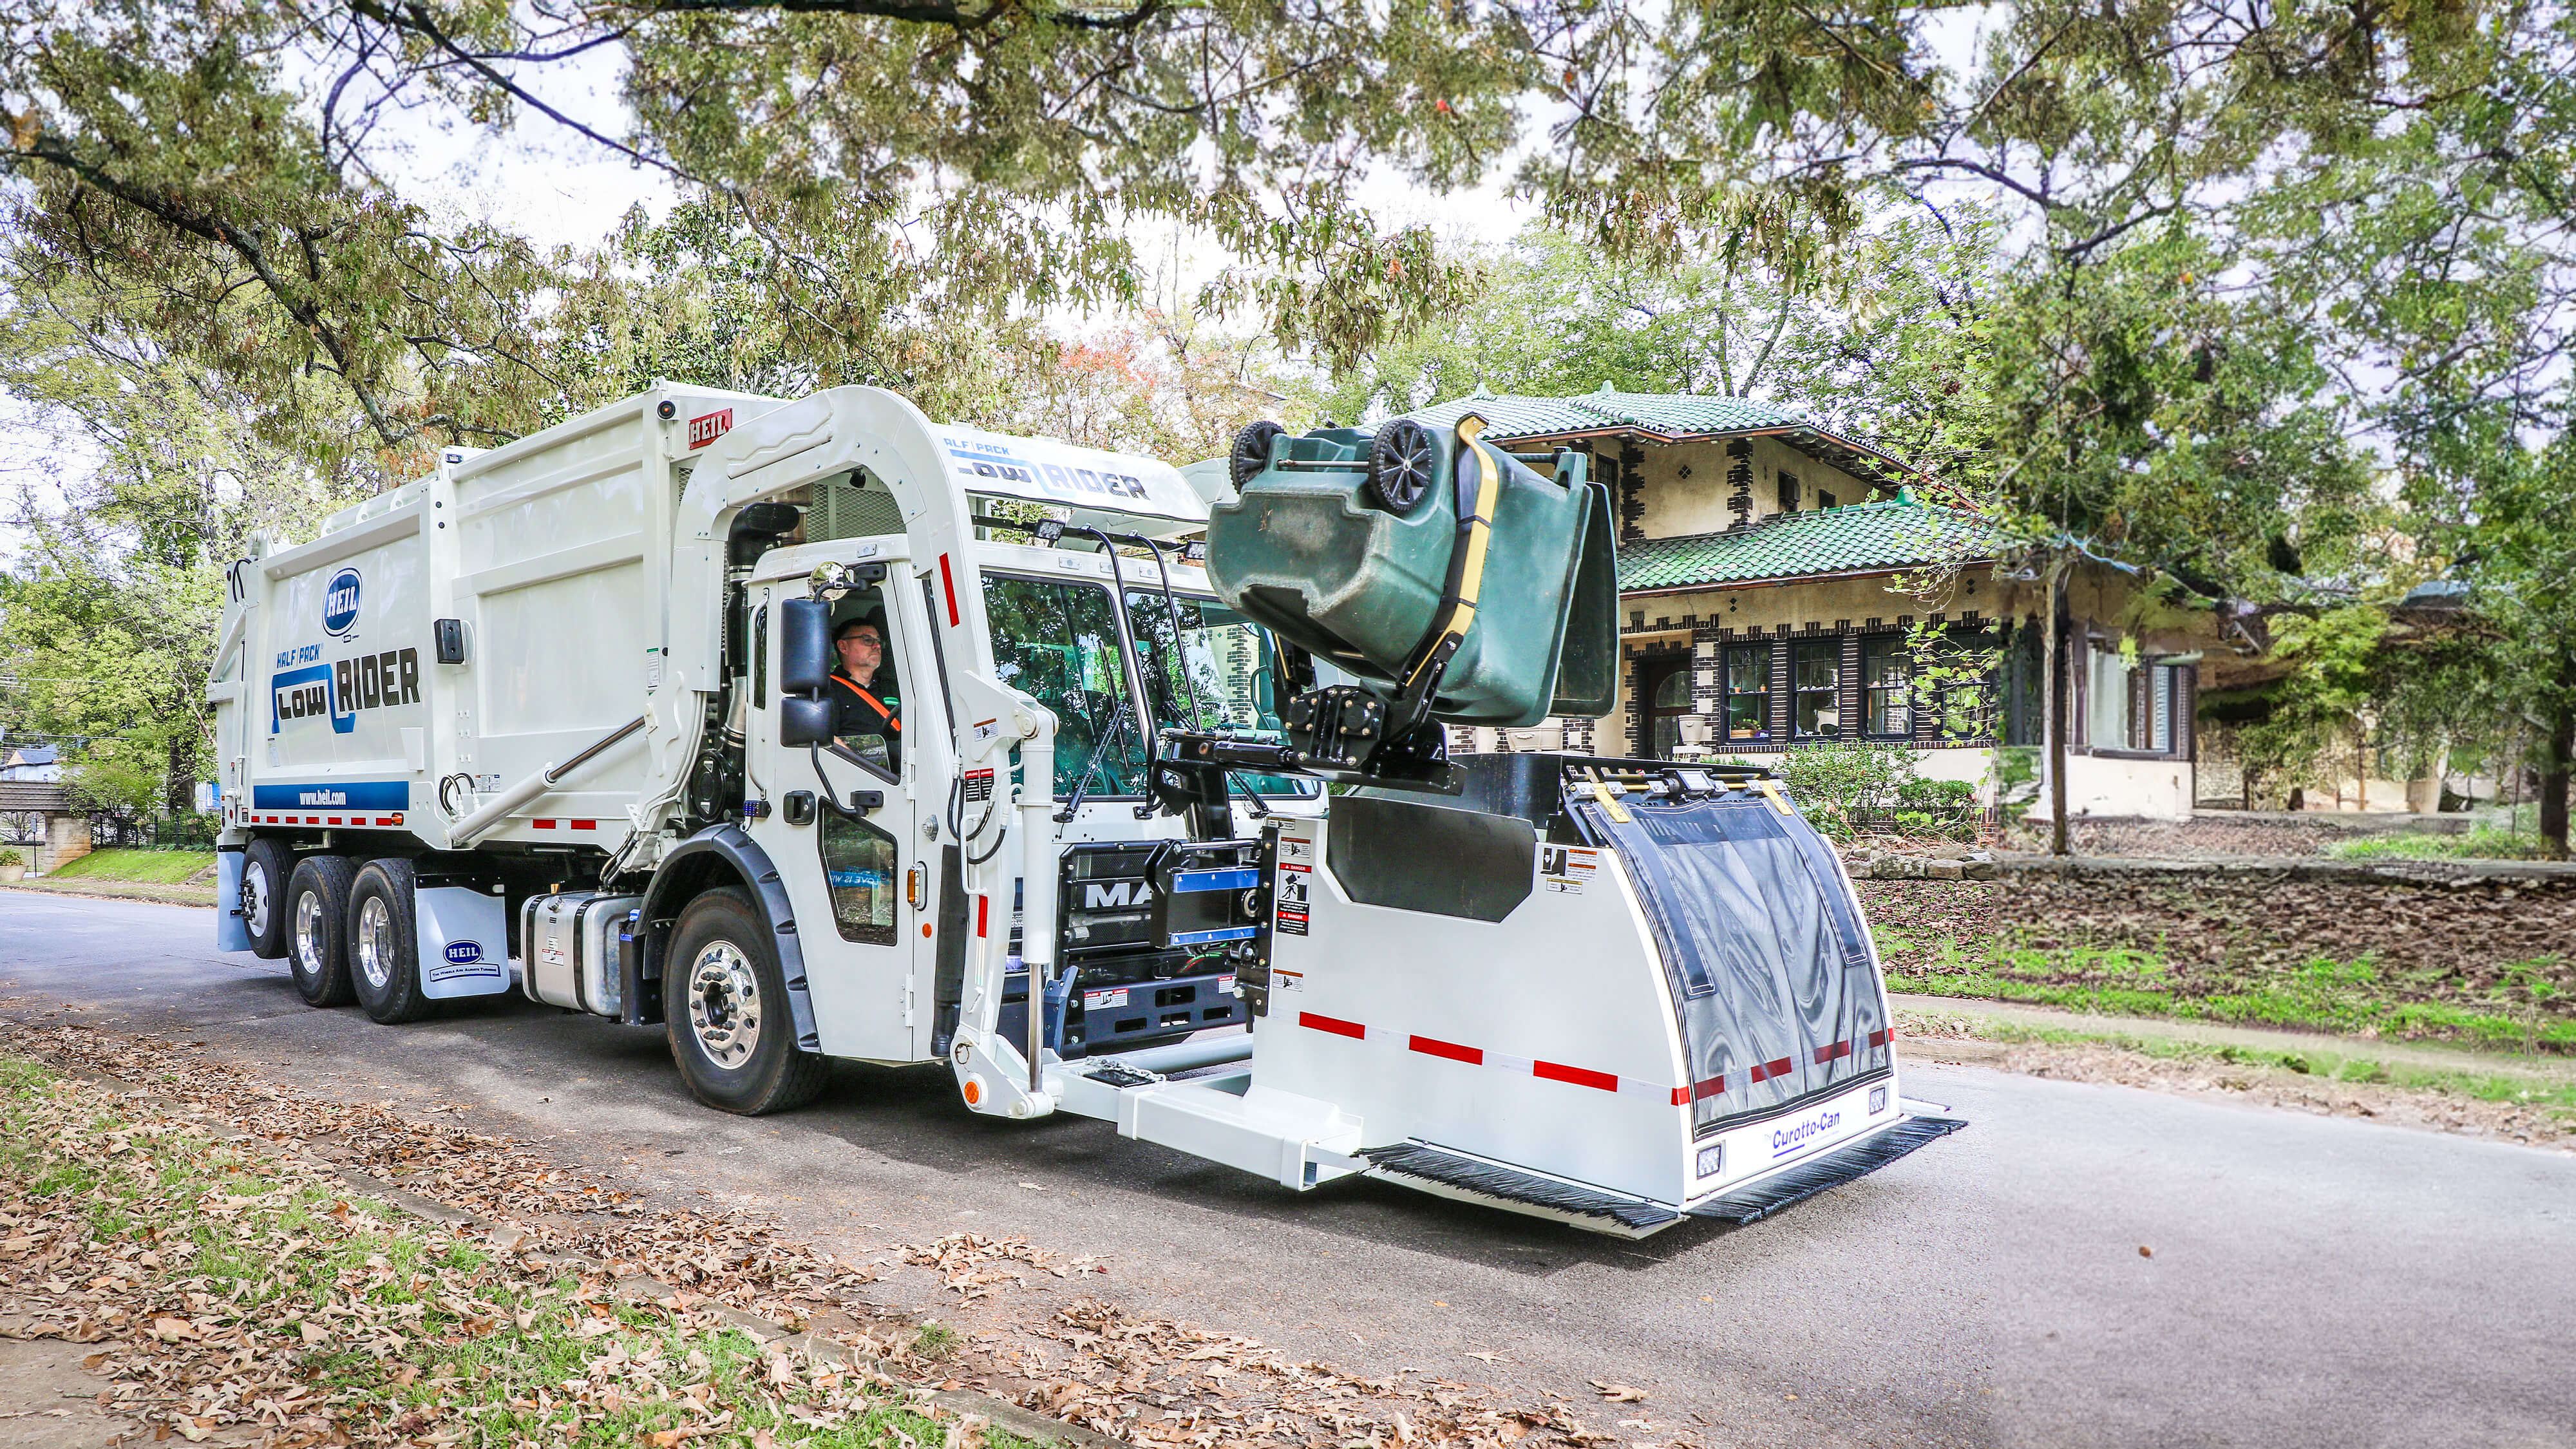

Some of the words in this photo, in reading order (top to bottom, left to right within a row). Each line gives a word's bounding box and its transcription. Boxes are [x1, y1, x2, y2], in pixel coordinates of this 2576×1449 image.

[690, 415, 726, 443] HEIL
[943, 438, 969, 449] ALF
[976, 442, 1010, 455] PACK
[1041, 462, 1151, 500] RIDER
[327, 585, 357, 618] HEIL
[277, 649, 297, 669] HALF
[299, 643, 321, 664] PACK
[278, 685, 326, 720] LOW
[337, 647, 421, 712] RIDER
[299, 788, 346, 805] www.heil.com
[1085, 881, 1155, 909] MA
[448, 947, 479, 958] HEIL
[1773, 1112, 1840, 1149] Curotto-Can
